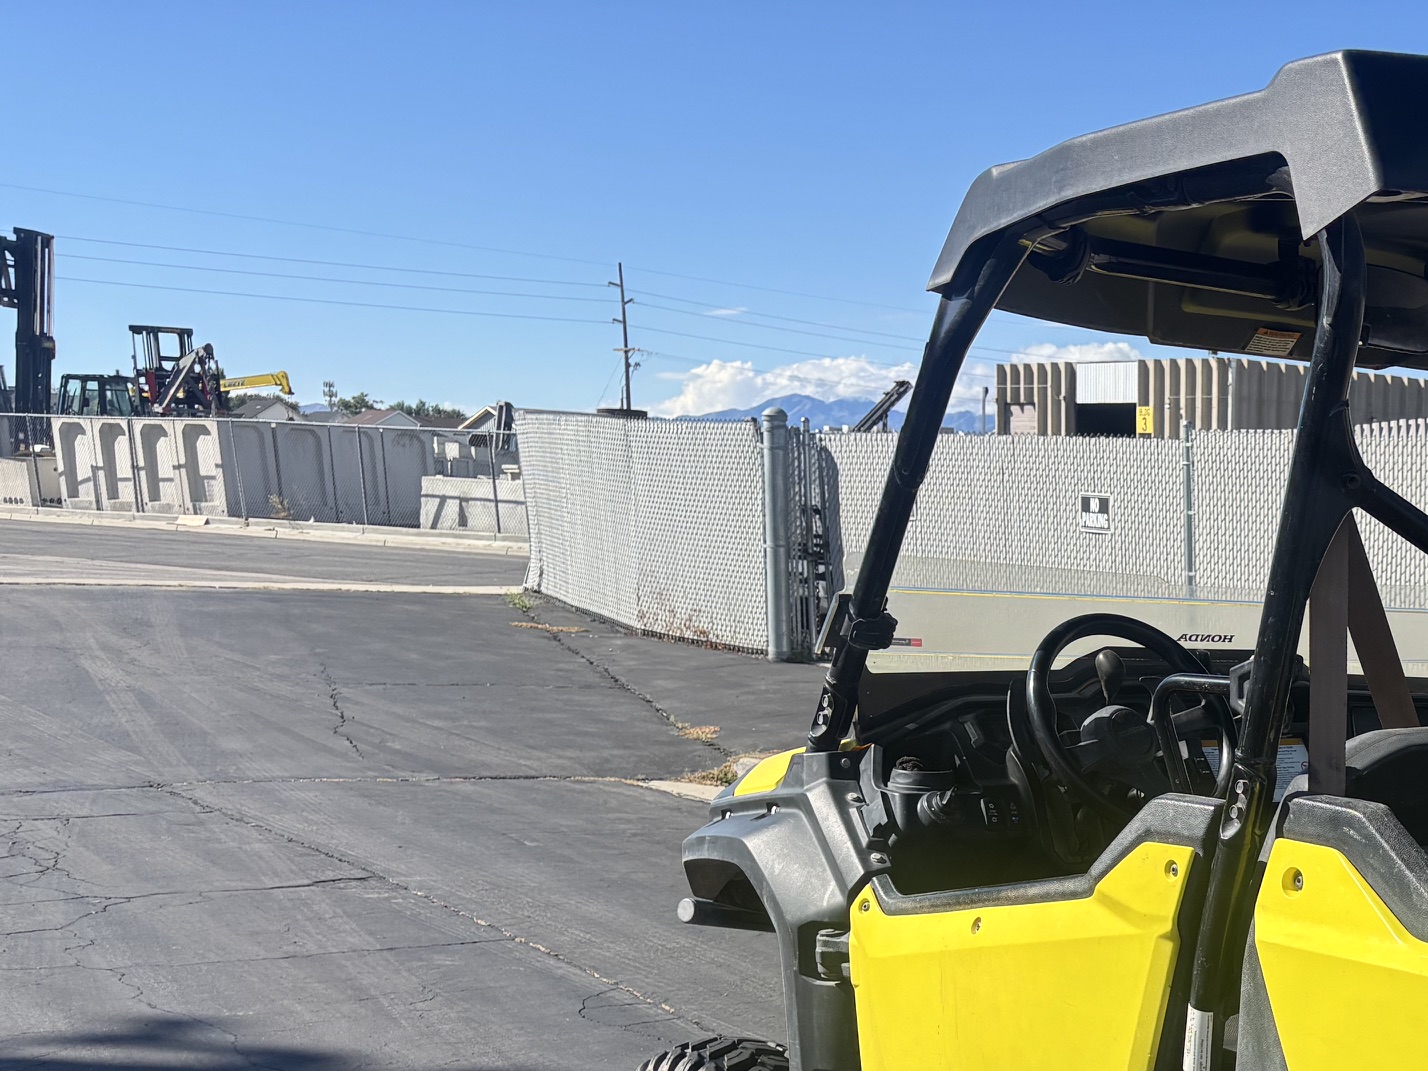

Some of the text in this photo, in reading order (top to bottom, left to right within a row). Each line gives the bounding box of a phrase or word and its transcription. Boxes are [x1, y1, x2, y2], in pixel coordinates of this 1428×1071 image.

[1141, 417, 1148, 431] 3
[1090, 498, 1099, 513] NO
[1081, 512, 1109, 529] PARKING
